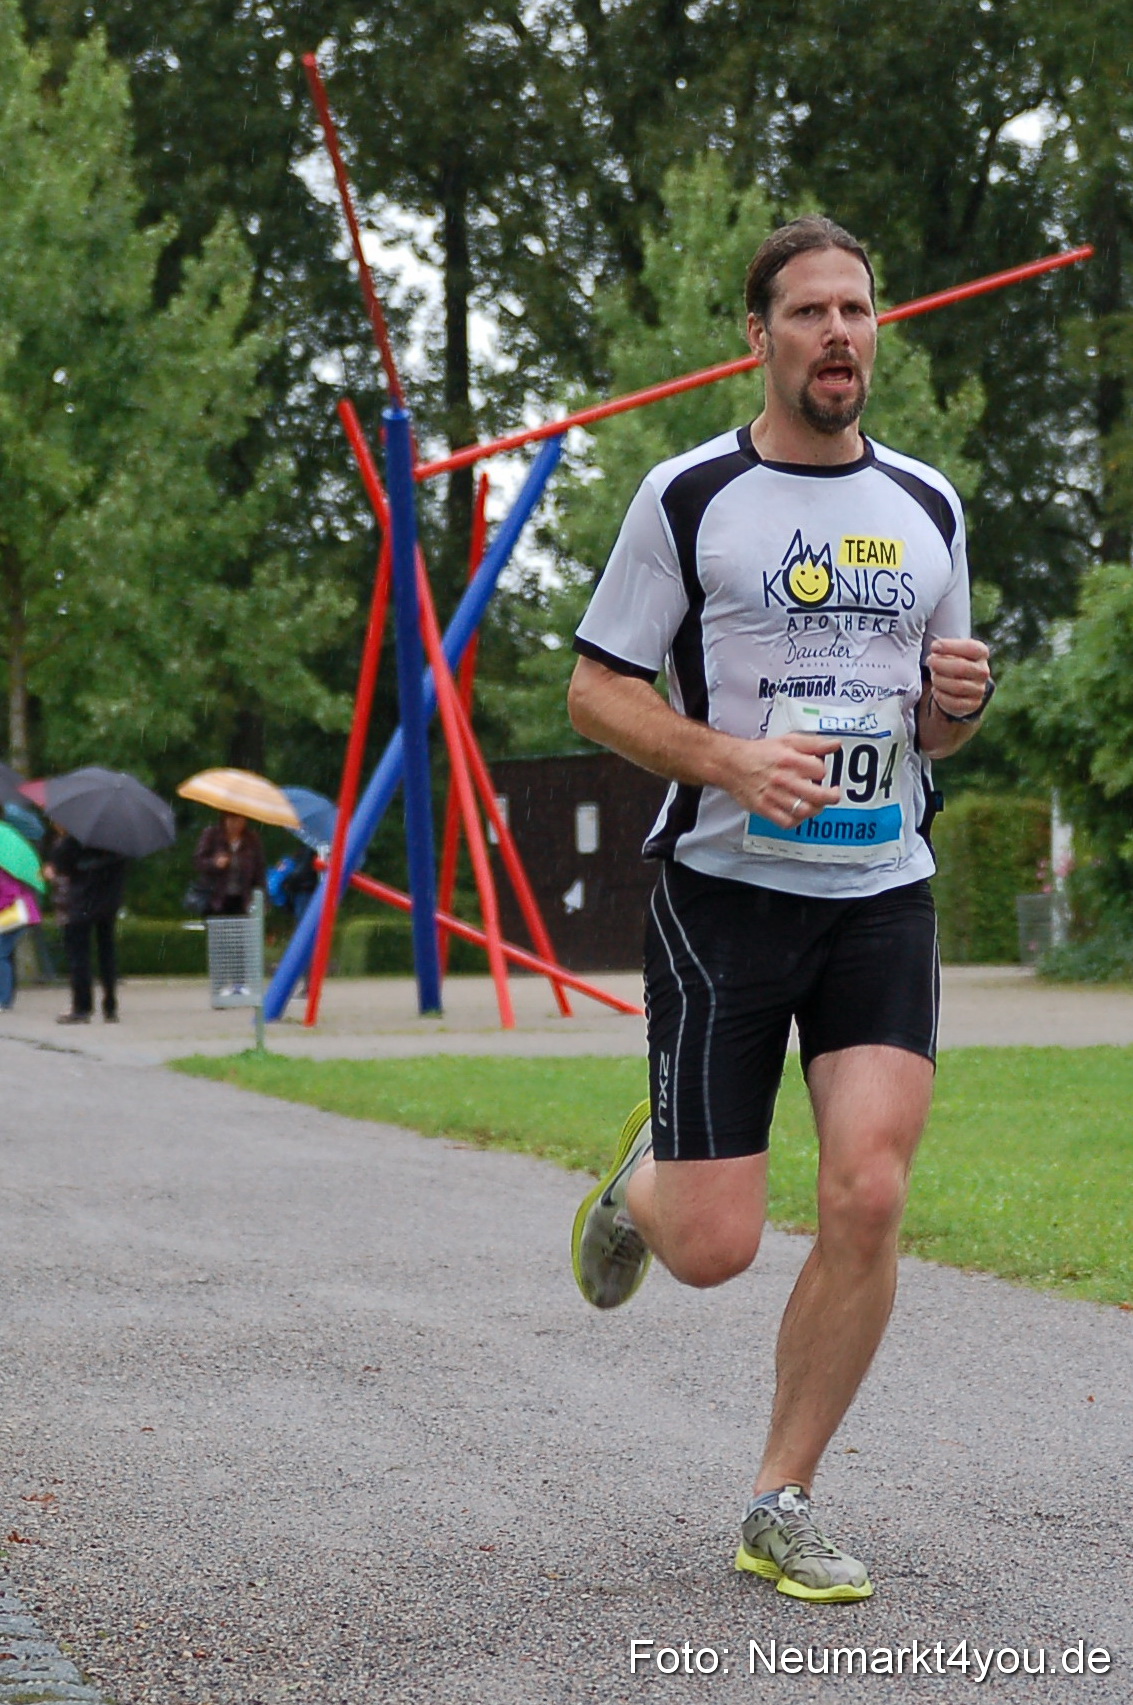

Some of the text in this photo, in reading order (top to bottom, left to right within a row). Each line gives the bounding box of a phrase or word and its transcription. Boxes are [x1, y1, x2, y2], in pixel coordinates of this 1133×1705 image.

[845, 539, 897, 565] TEAM
[786, 615, 899, 634] APOTHEKE
[784, 632, 854, 665] Daucher
